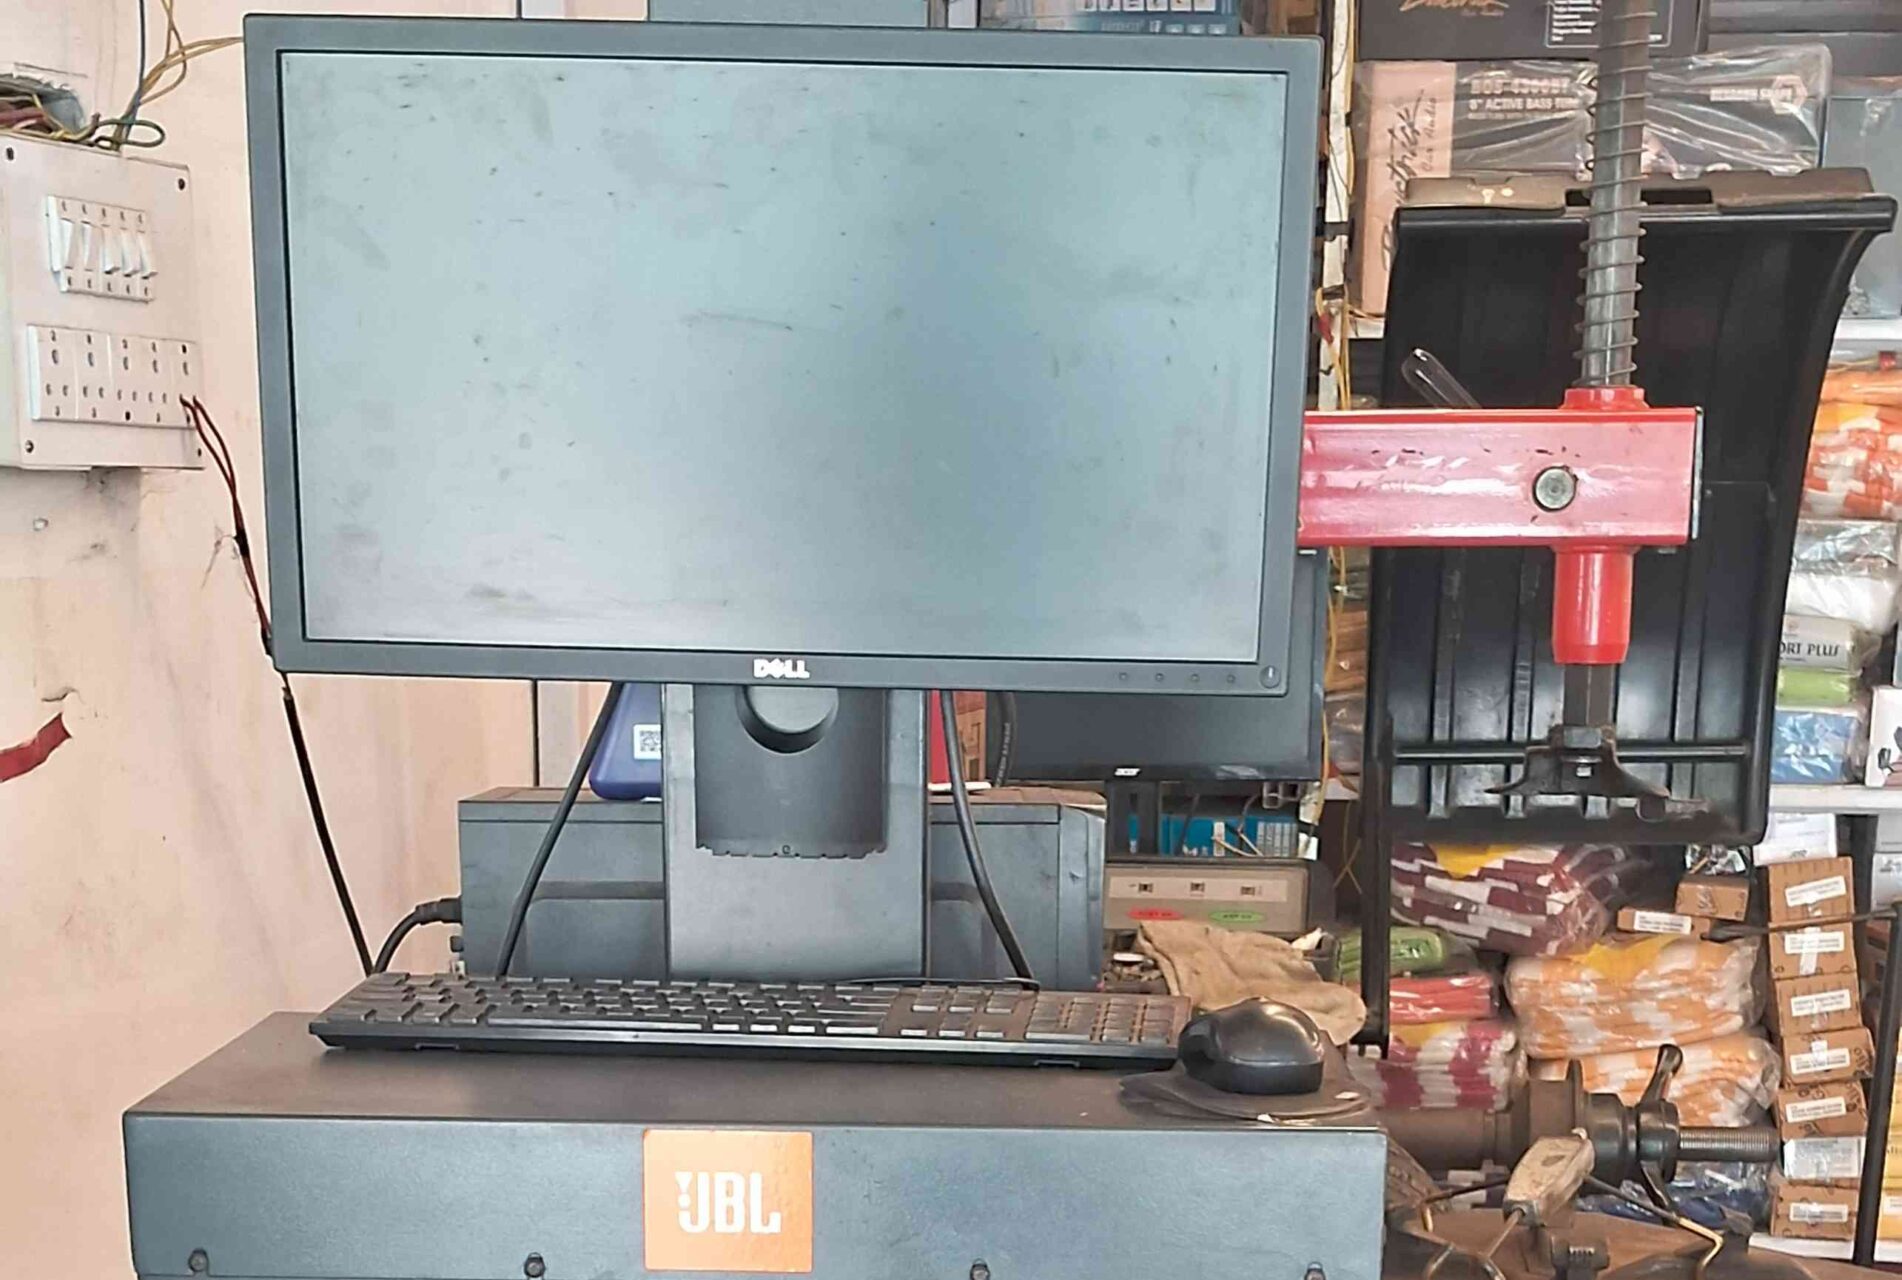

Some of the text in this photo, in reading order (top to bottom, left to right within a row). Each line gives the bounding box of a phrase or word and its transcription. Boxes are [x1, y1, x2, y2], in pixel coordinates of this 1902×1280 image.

[1486, 98, 1523, 111] ACTIVE
[1525, 97, 1553, 110] BASS
[1779, 640, 1840, 657] ORT PLUS
[753, 658, 810, 679] DELL
[676, 1171, 782, 1234] JBL
